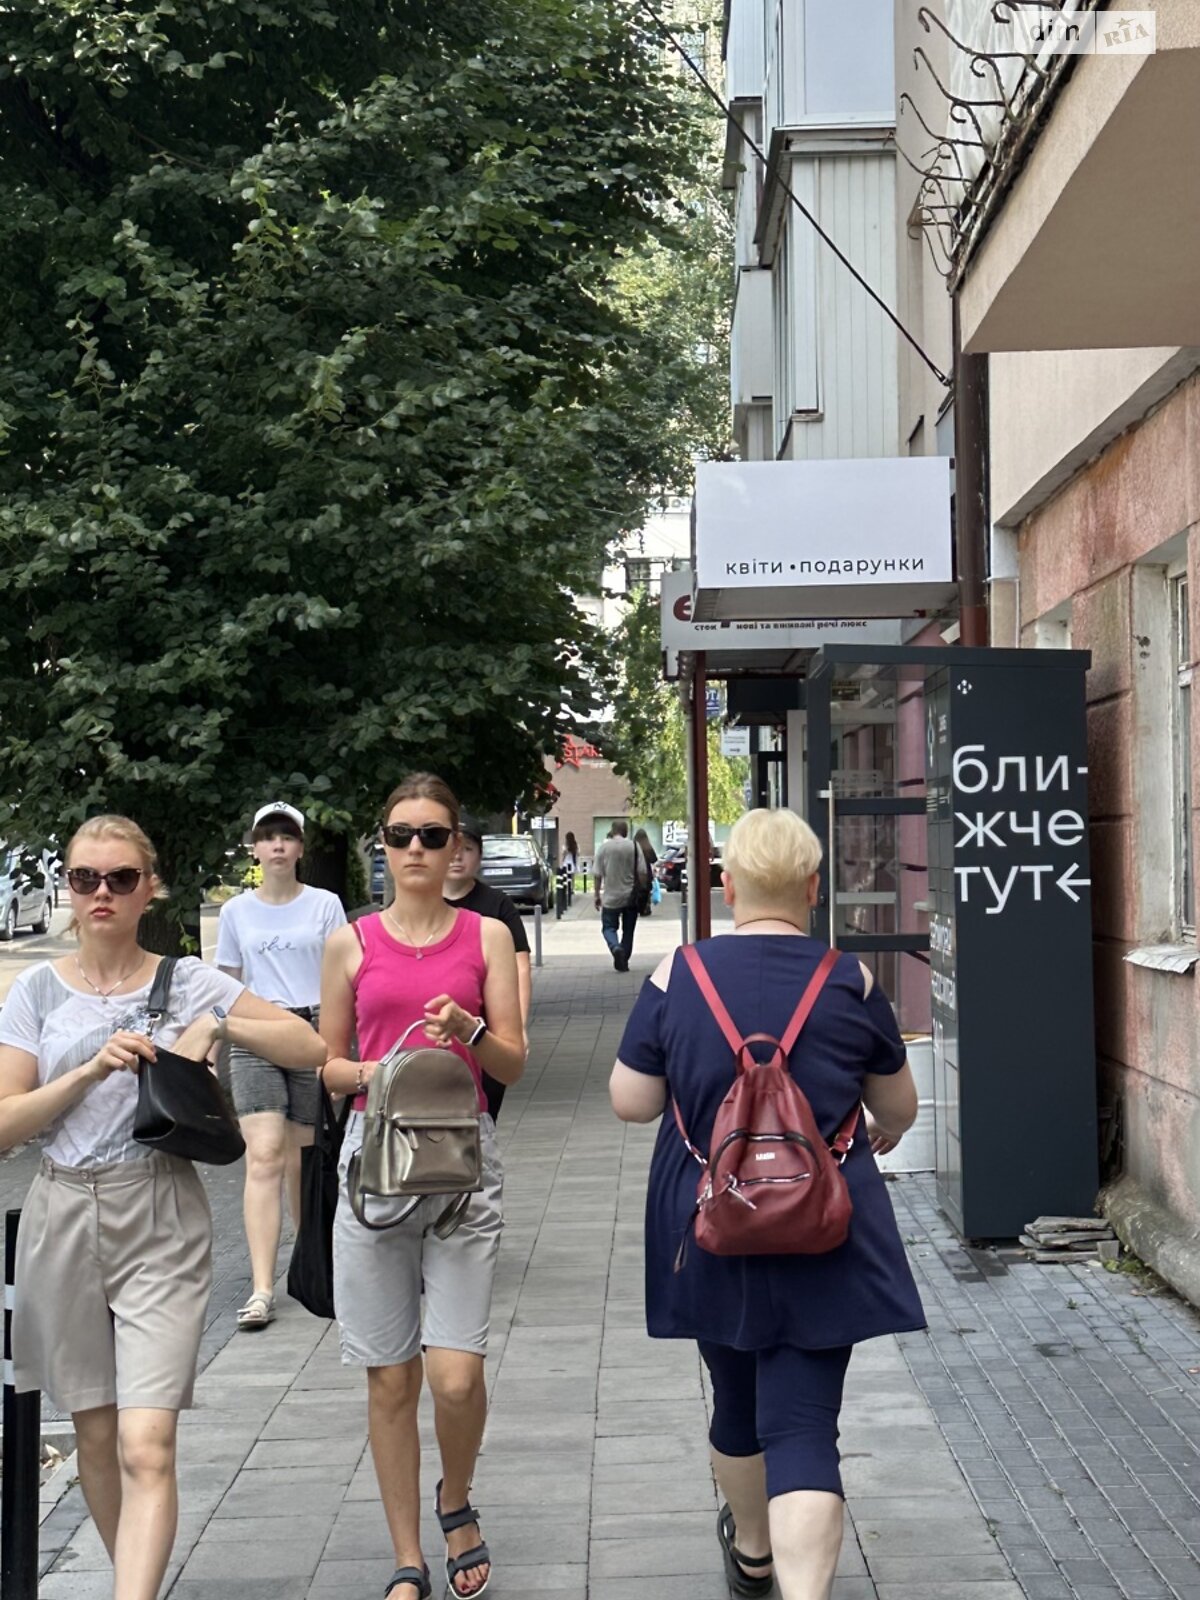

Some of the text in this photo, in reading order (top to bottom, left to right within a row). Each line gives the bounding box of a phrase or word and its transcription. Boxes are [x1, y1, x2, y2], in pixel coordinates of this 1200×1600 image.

[726, 557, 925, 576] квіти подарунки
[952, 744, 1089, 794] бли-
[954, 809, 1085, 848] жче
[953, 862, 1054, 915] тут
[258, 935, 297, 955] she
